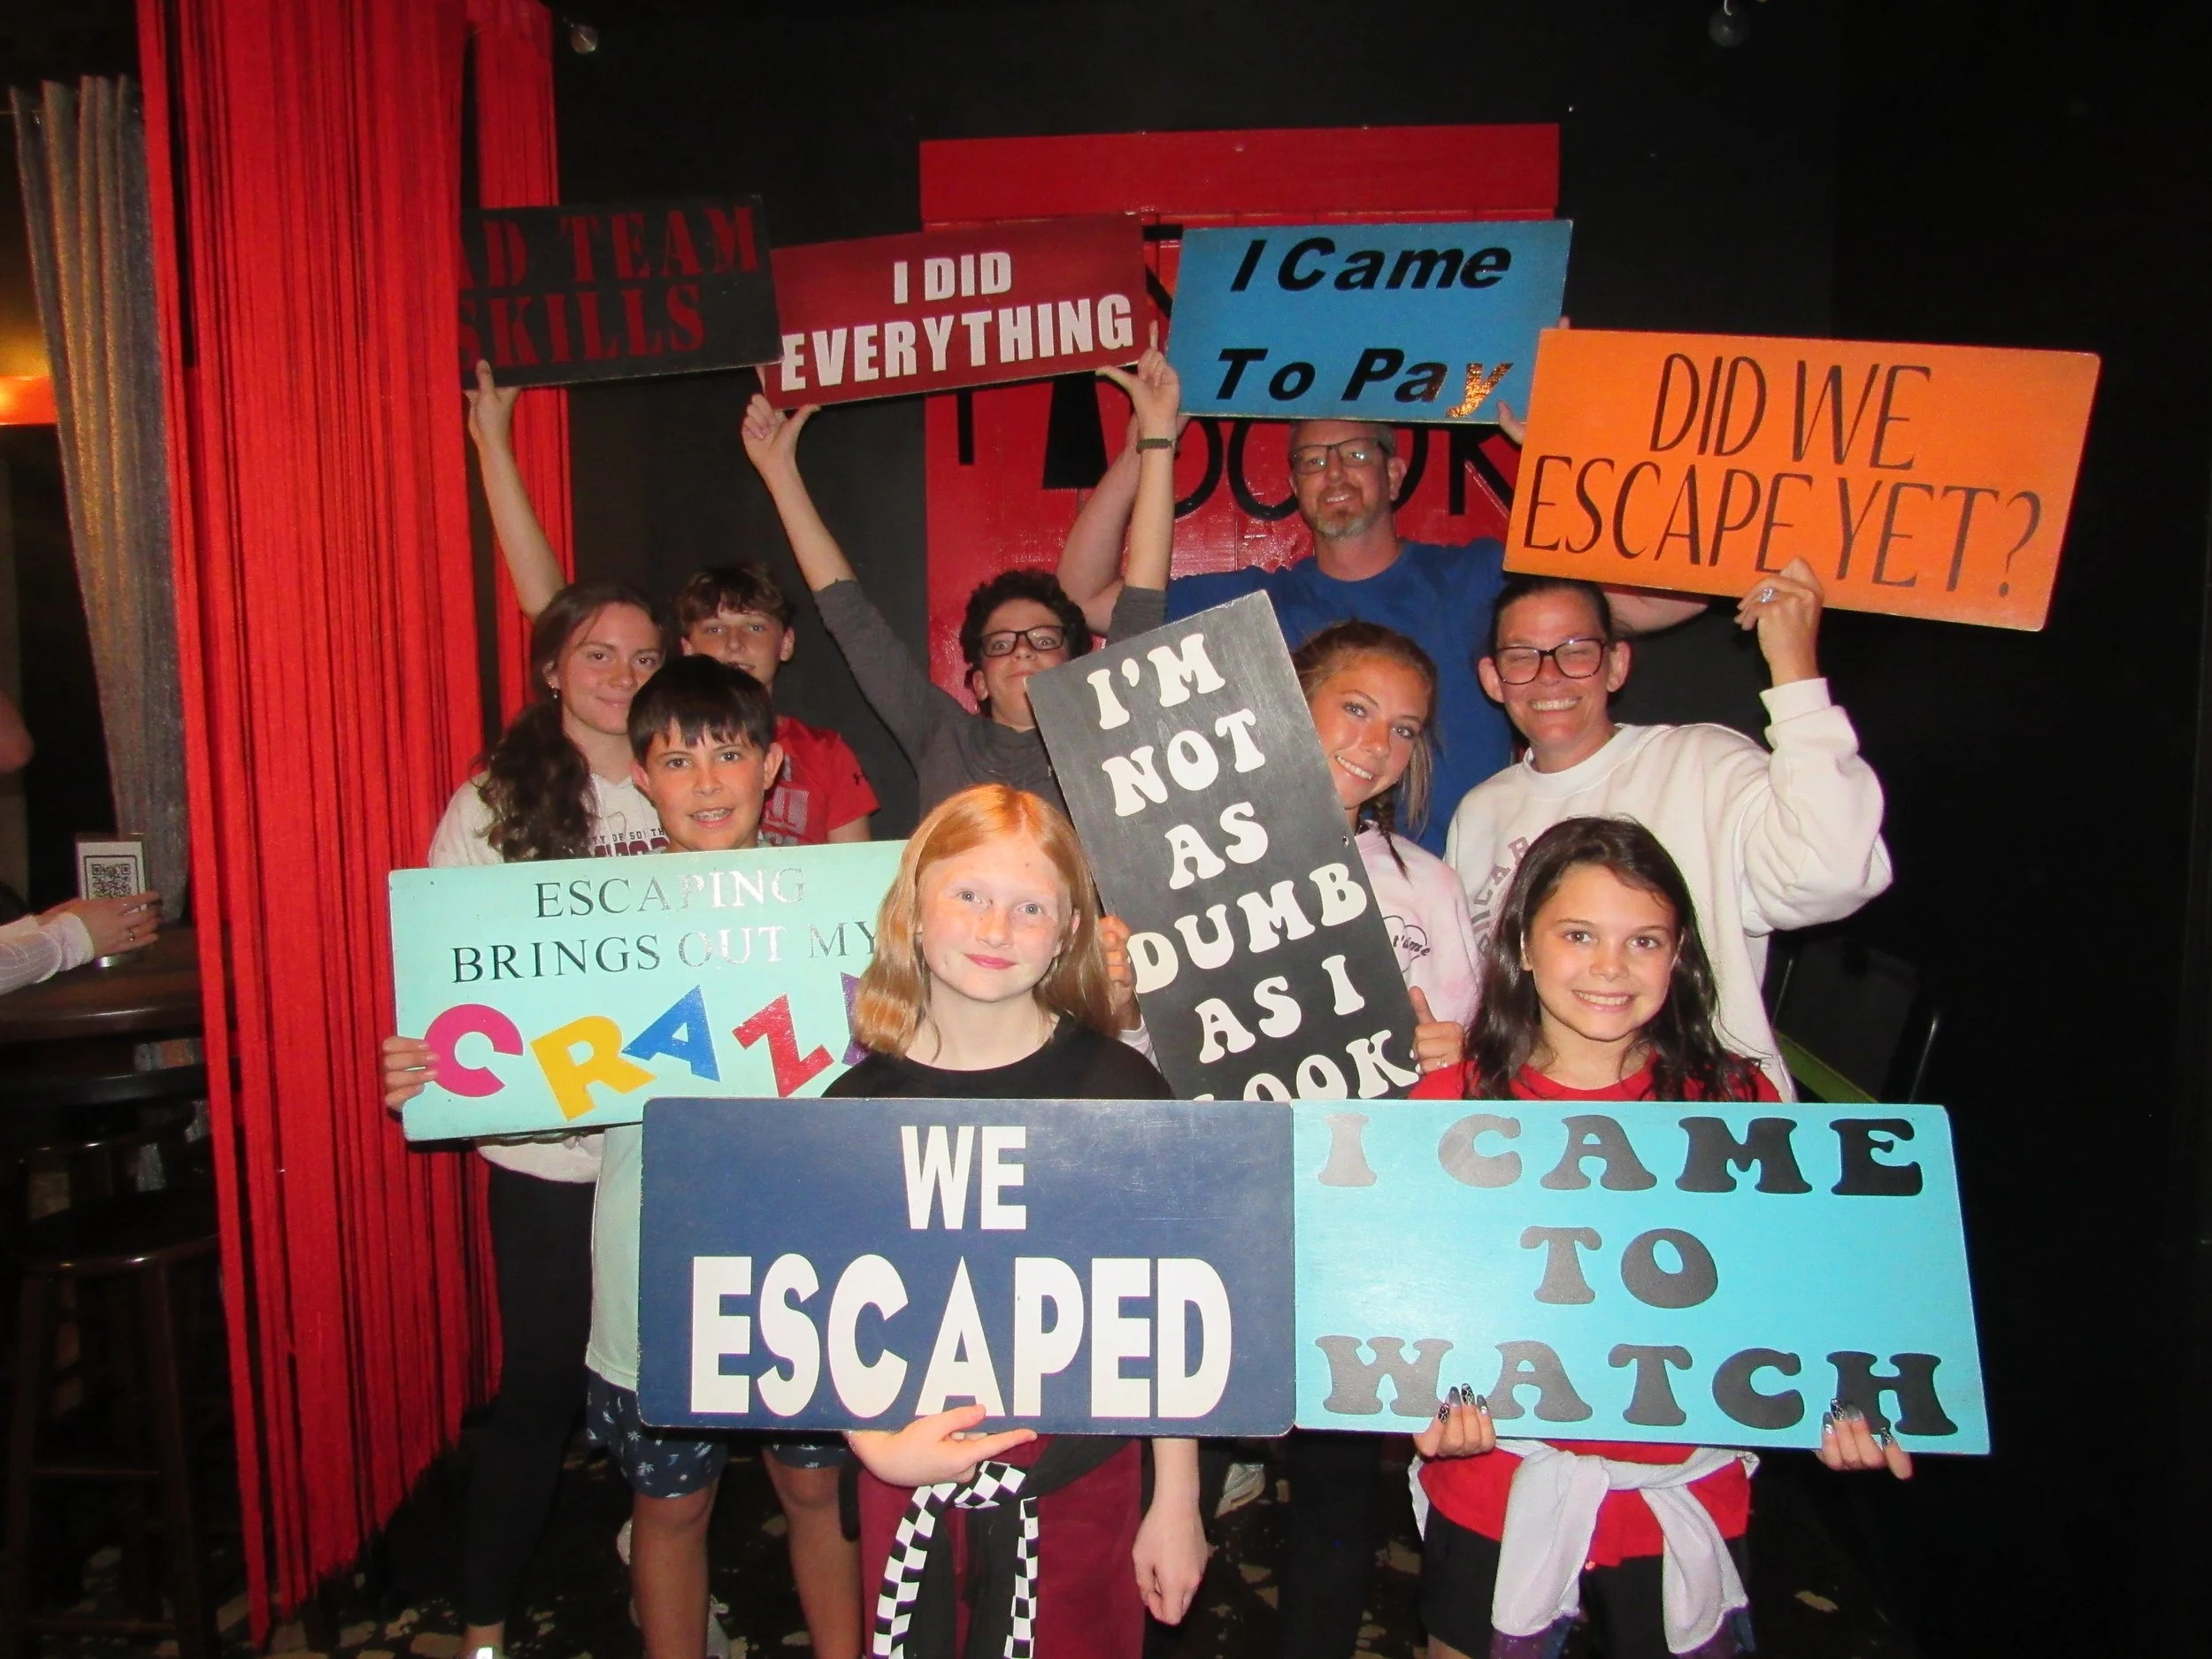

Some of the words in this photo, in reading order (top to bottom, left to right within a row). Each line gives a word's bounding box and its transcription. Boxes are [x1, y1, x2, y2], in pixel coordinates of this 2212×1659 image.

[560, 206, 759, 283] TEAM
[894, 261, 909, 304] I
[924, 251, 1012, 301] DID
[1230, 239, 1267, 292] I
[1278, 236, 1512, 290] Came
[781, 294, 1133, 392] EVERYTHING
[1216, 348, 1315, 401] To
[1340, 348, 1514, 418] Pay
[1649, 353, 1768, 457] DID
[1792, 359, 1932, 471] WE
[1523, 455, 1814, 574] ESCAPE
[1836, 477, 2041, 598] YET?
[1087, 633, 1225, 730] I'M
[1102, 708, 1266, 817] NOT
[1164, 802, 1269, 890] AS
[534, 867, 807, 918] ESCAPING
[1126, 863, 1368, 995] DUMB
[450, 933, 661, 984] BRINGS
[678, 926, 786, 968] OUT
[808, 920, 876, 958] MY
[1194, 975, 1302, 1064] AS
[1321, 954, 1365, 1016] I
[1193, 1029, 1419, 1100] OOK
[901, 1125, 1026, 1230] WE
[1317, 1113, 1378, 1187] I
[1437, 1113, 1923, 1196] CAME
[1519, 1225, 1718, 1310] TO
[690, 1253, 1233, 1418] ESCAPED
[1315, 1334, 1958, 1436] WATCH
